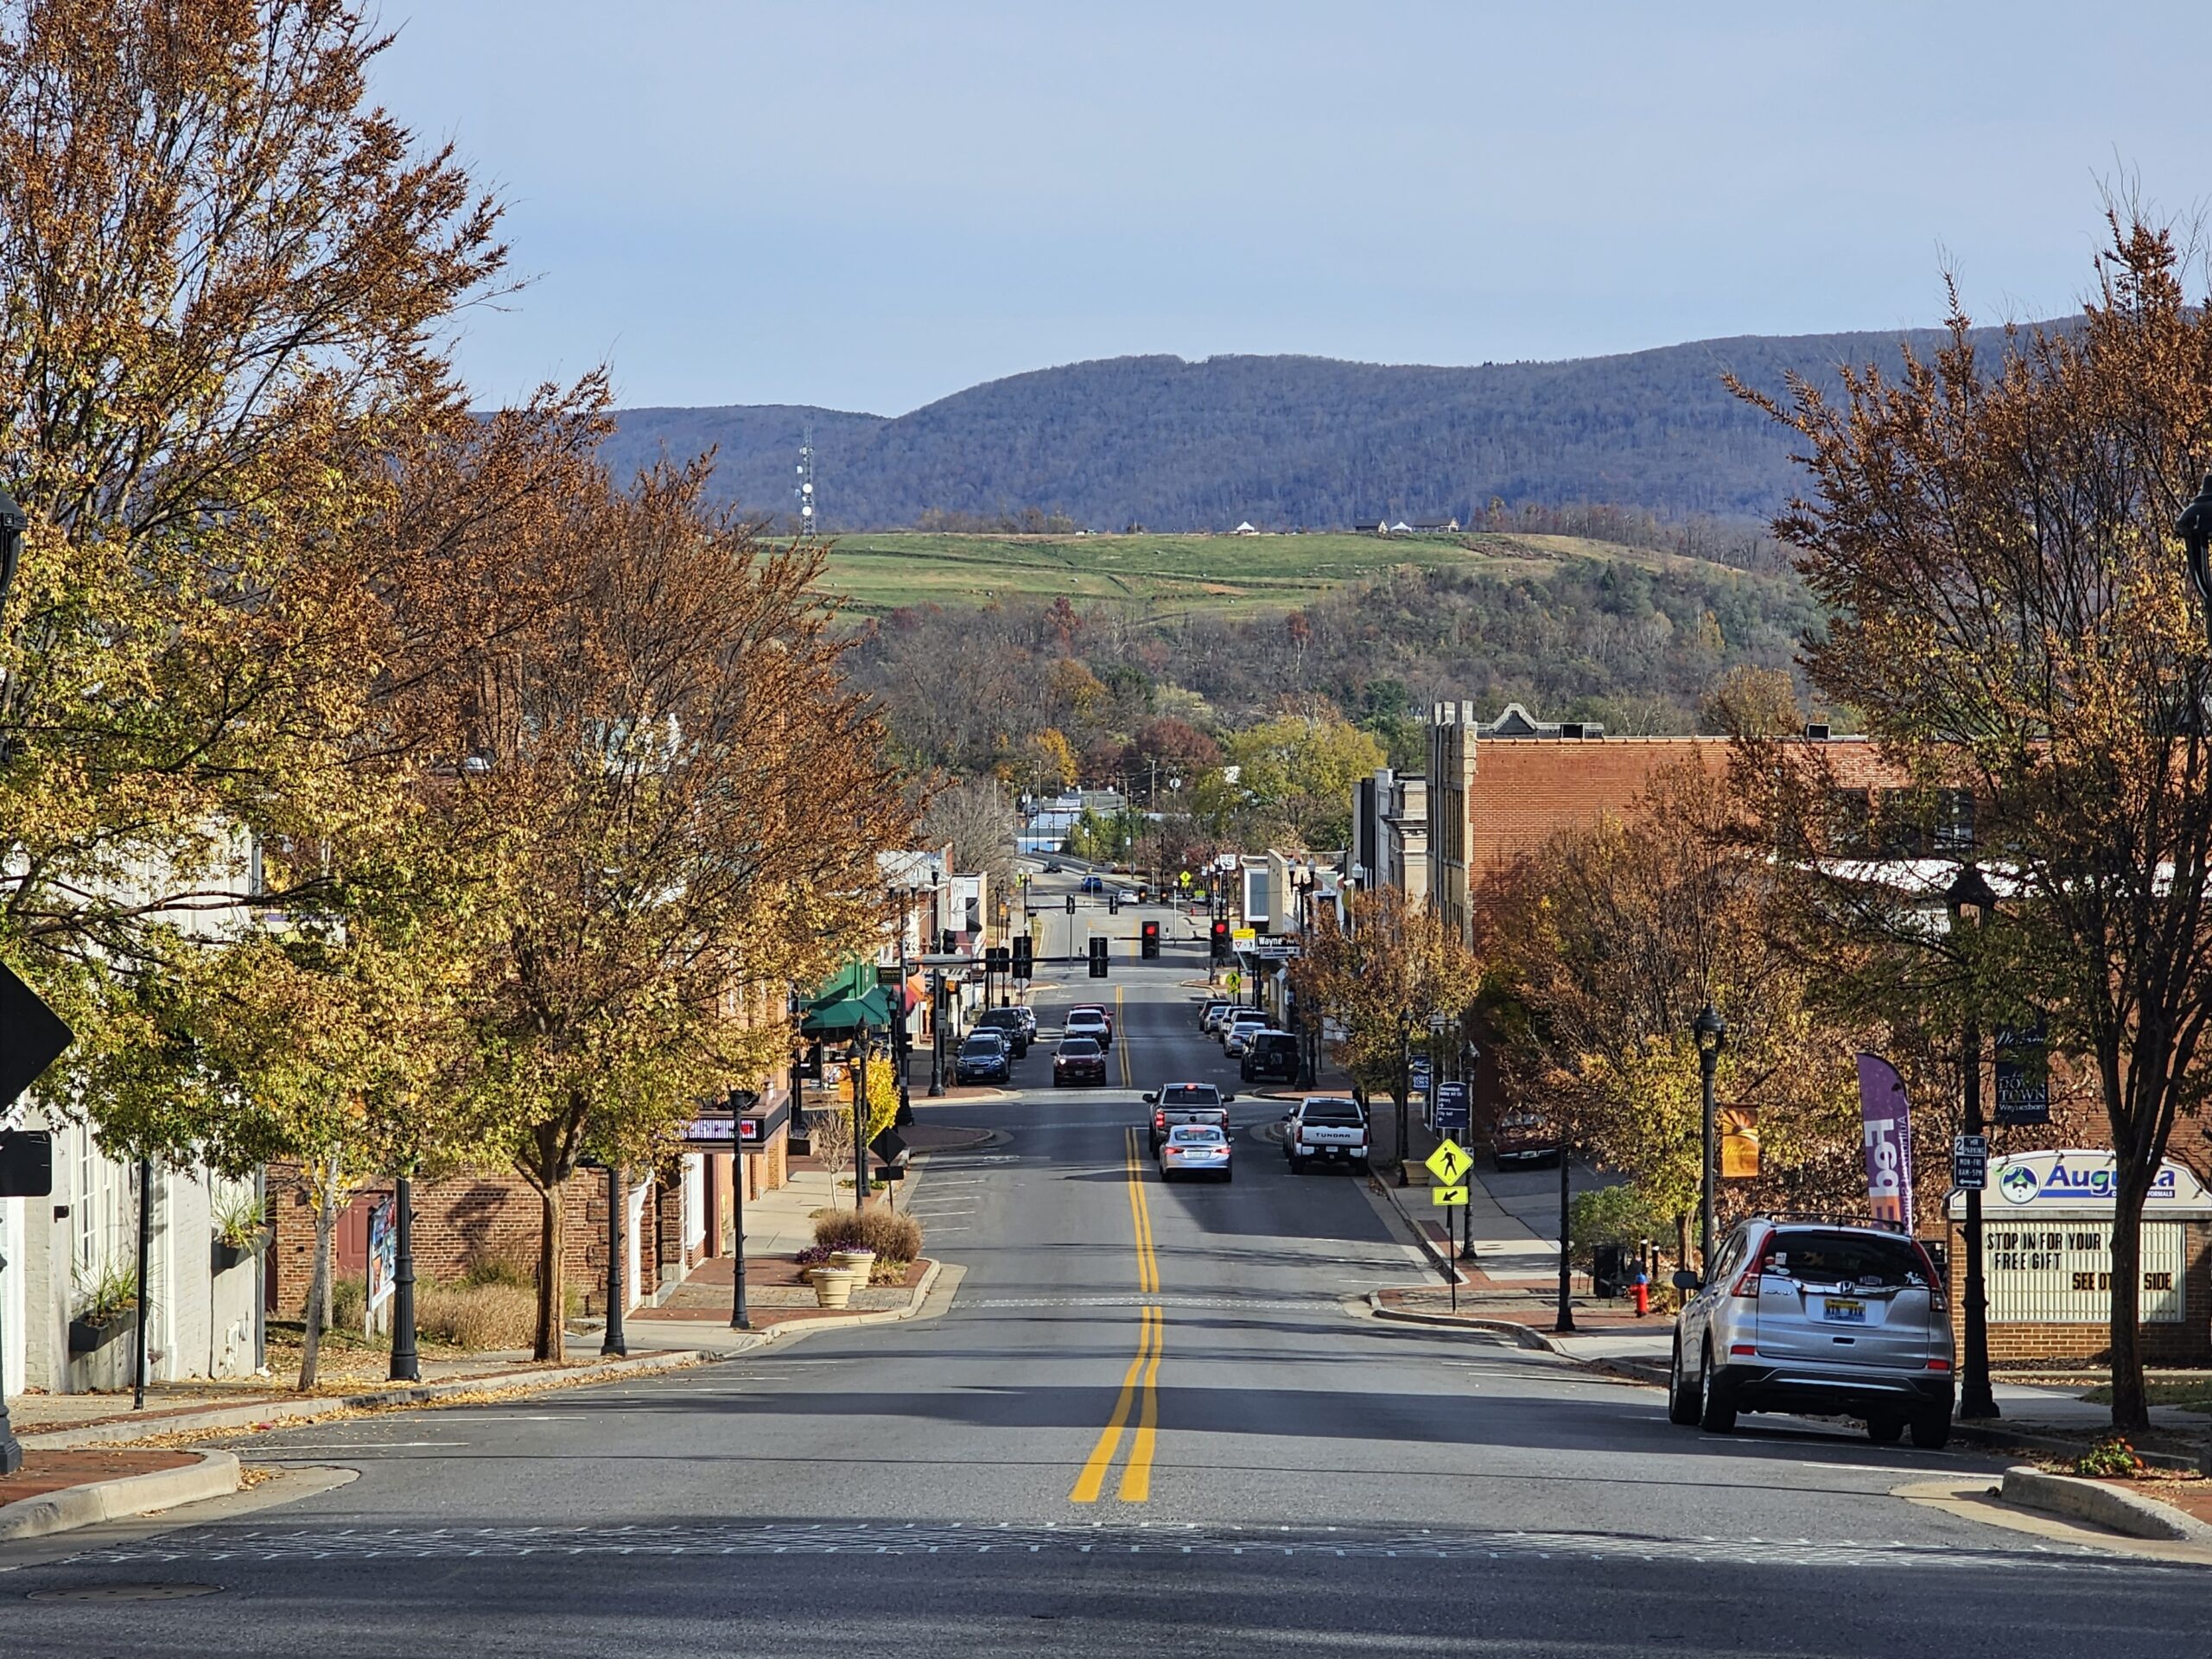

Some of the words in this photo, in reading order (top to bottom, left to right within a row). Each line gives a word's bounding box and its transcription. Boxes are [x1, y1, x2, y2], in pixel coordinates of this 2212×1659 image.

[1258, 937, 1282, 947] Wayne
[1999, 1103, 2045, 1113] Waynesboro
[1955, 1139, 1963, 1153] 2
[1987, 1233, 2018, 1250] STOP
[2023, 1233, 2036, 1250] IN
[2040, 1233, 2063, 1250] FOR
[2069, 1233, 2101, 1250] YOUR
[1995, 1253, 2026, 1270] FREE
[2032, 1253, 2061, 1270] GIFT
[2074, 1273, 2094, 1290] SEE
[2145, 1273, 2171, 1291] SIDE
